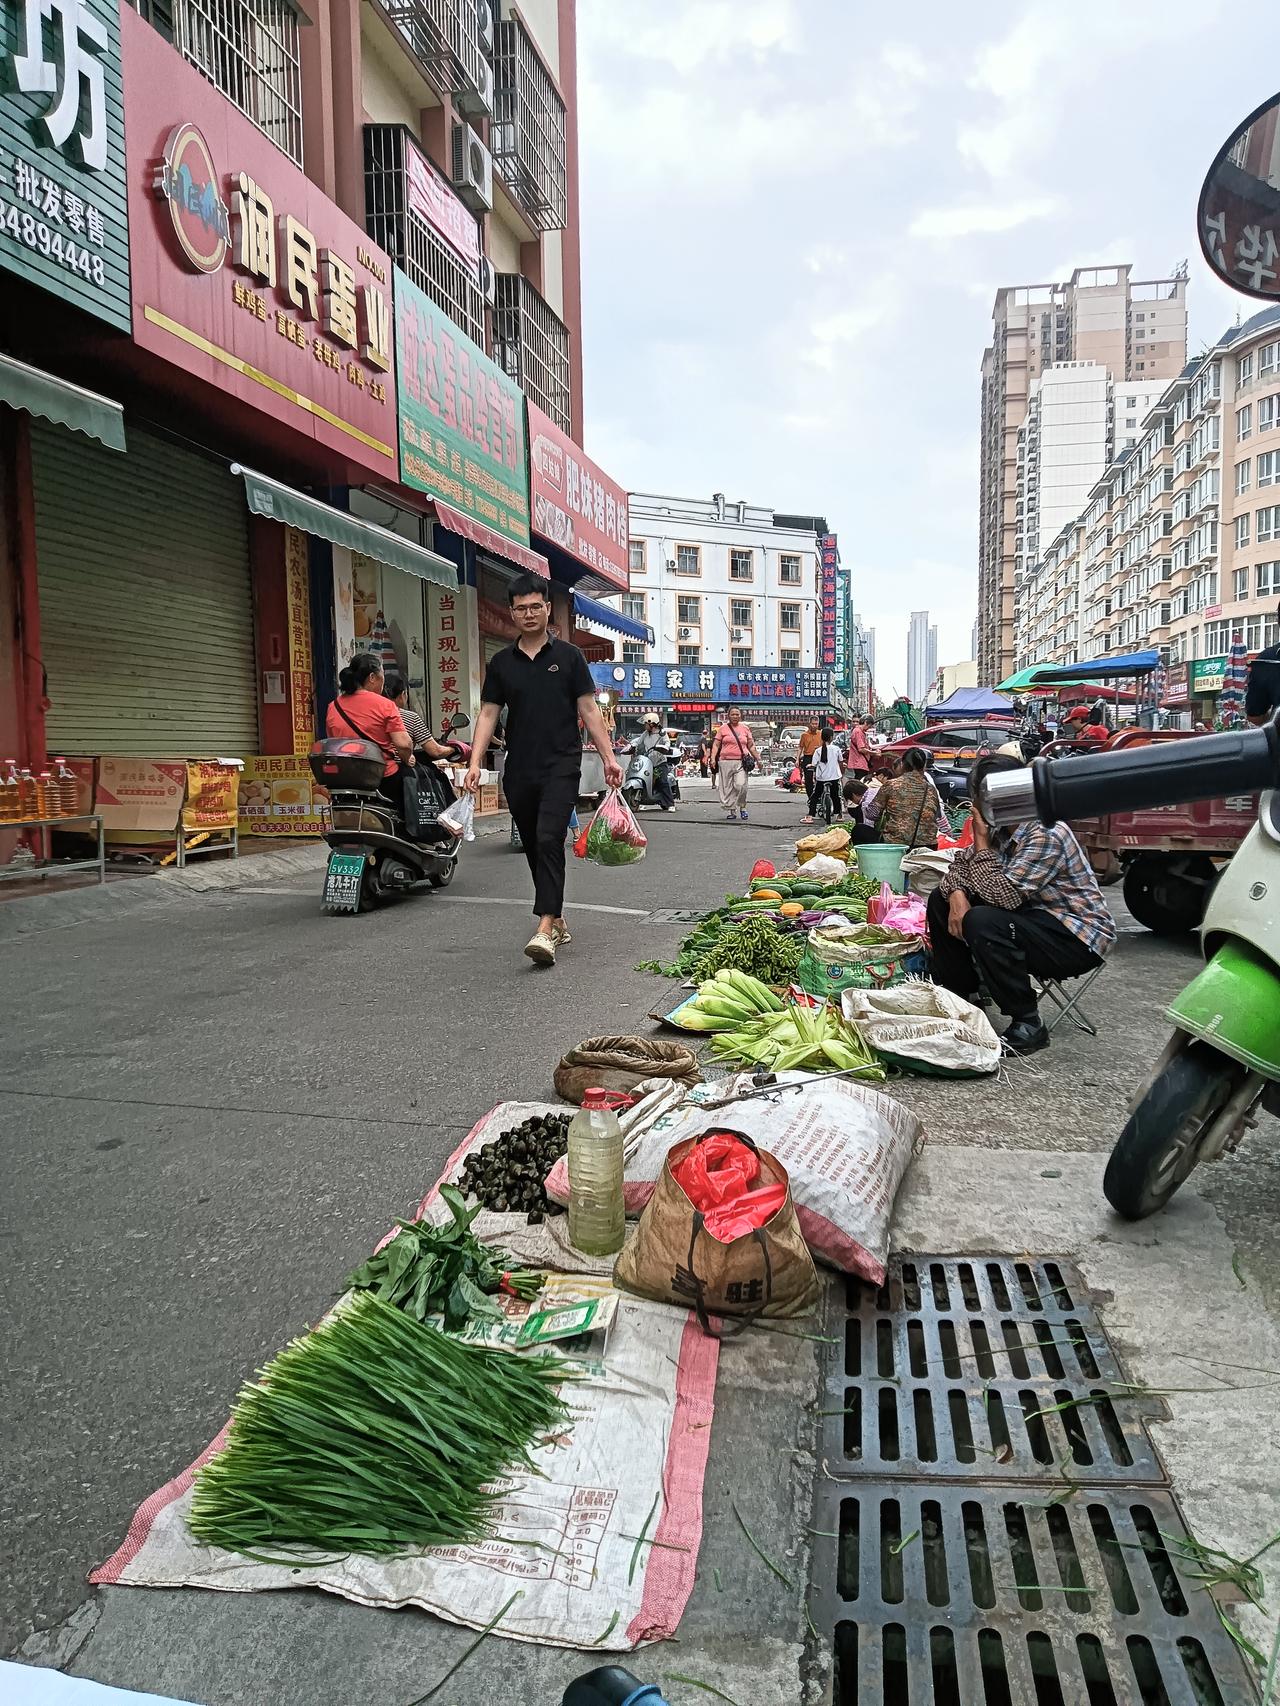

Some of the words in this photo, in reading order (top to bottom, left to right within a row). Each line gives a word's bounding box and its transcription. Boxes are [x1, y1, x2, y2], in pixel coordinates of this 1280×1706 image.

[15, 157, 104, 248] 批发零售
[231, 170, 391, 373] 润民蛋业
[823, 536, 836, 664] 渔家村海鲜加工酒楼
[633, 668, 715, 690] 渔家村
[278, 806, 305, 815] 玉米蛋
